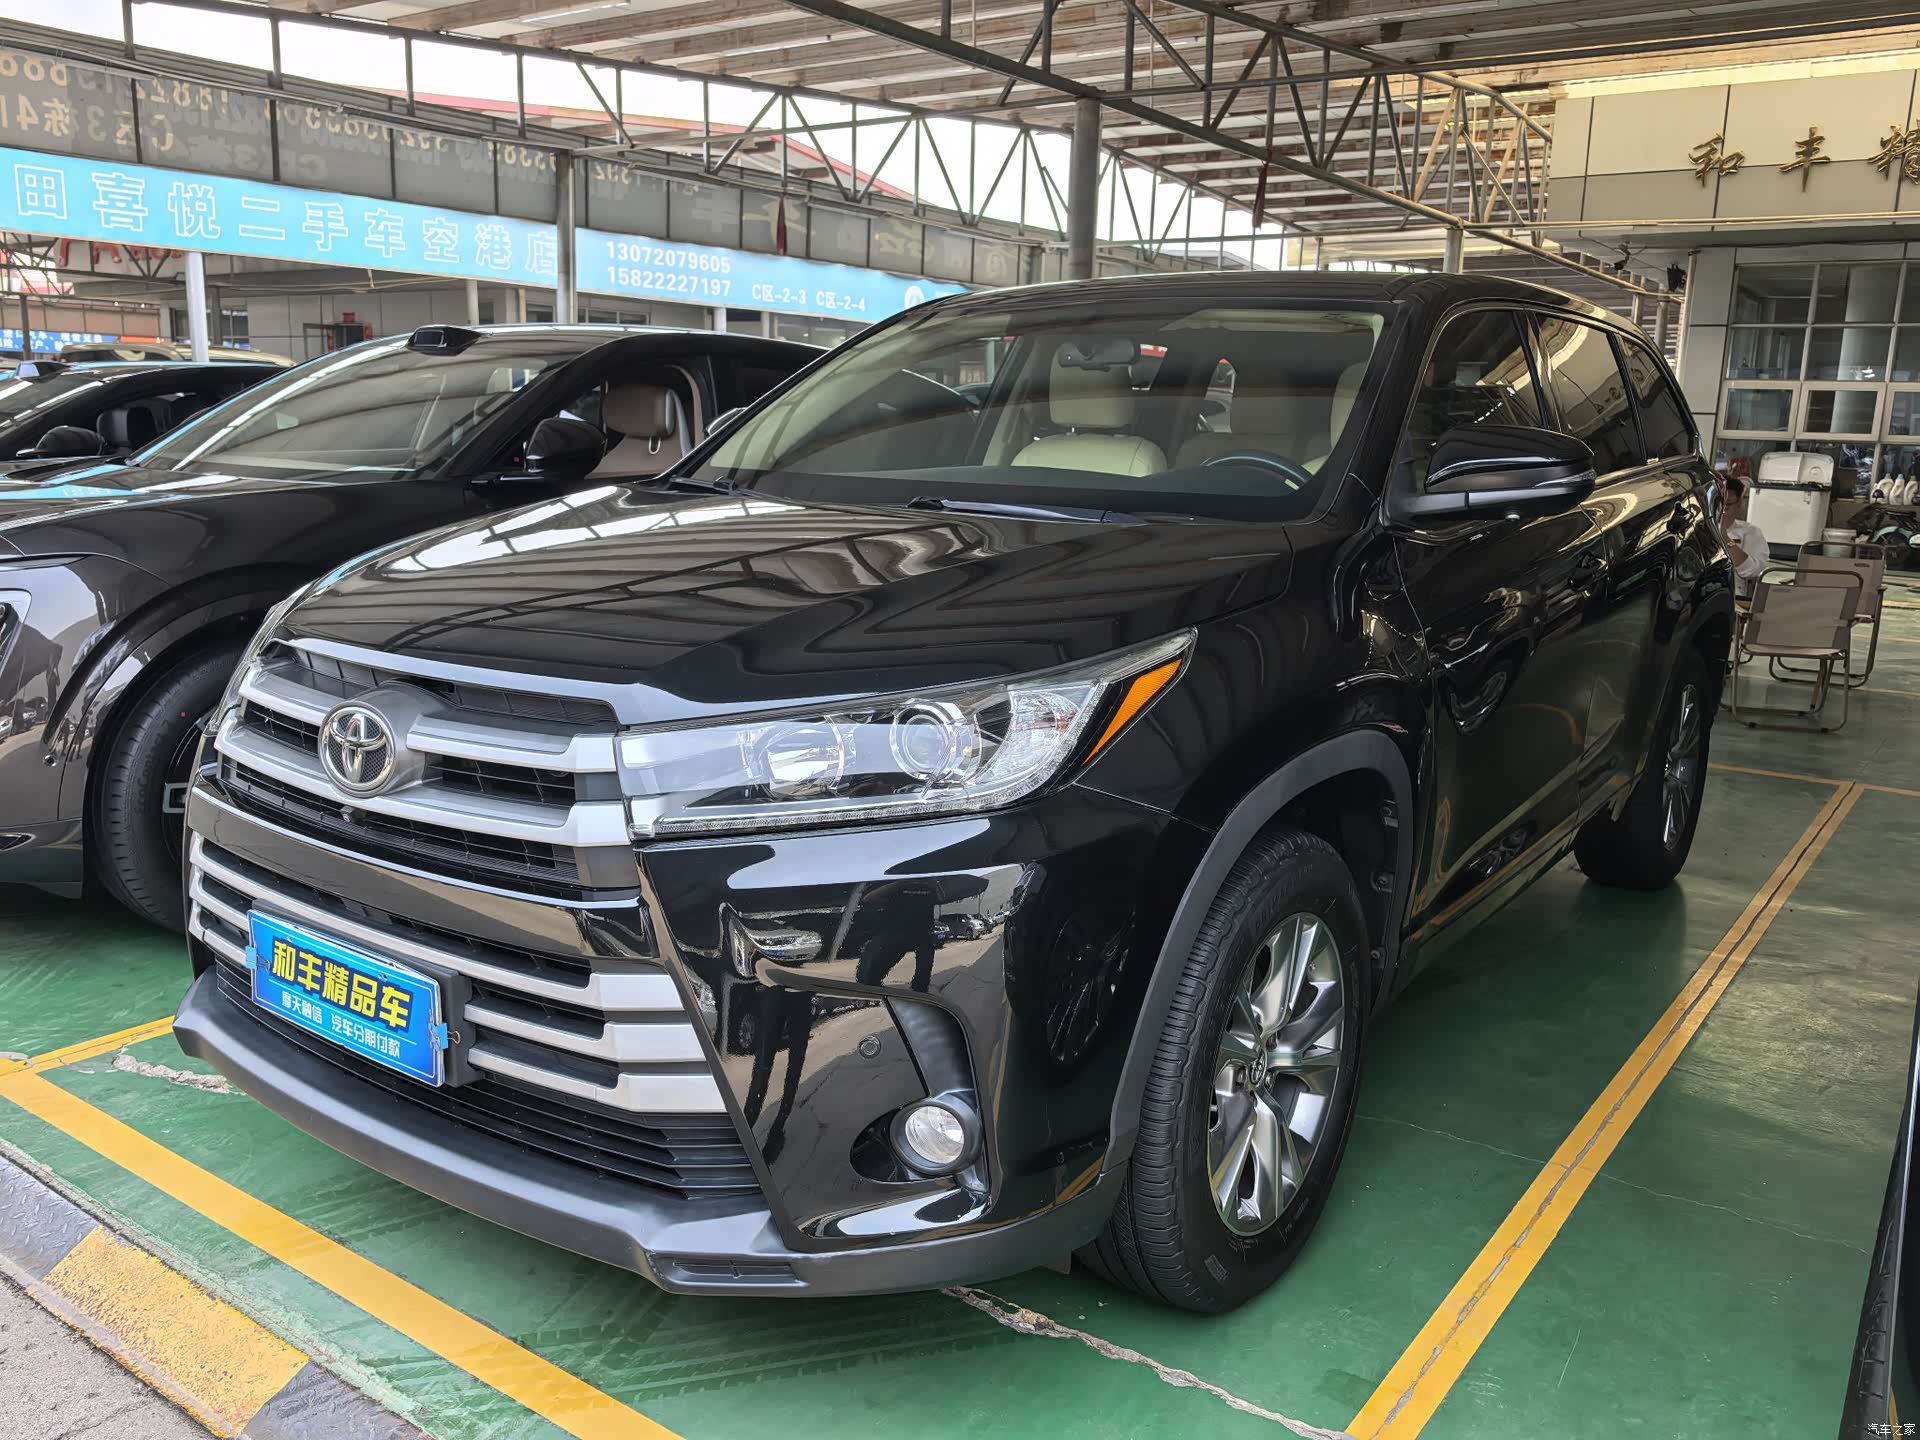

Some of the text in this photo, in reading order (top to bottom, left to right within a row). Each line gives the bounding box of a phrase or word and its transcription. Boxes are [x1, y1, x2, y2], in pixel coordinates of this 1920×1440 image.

[14, 163, 557, 275] 田喜悦二手车空港店
[606, 240, 731, 274] 13072079605
[607, 266, 731, 297] 15822227197
[752, 285, 866, 312] C区-2-3 C区-2-4
[272, 939, 410, 1028] 和丰精品车
[331, 1013, 400, 1058] 汽车分期付款
